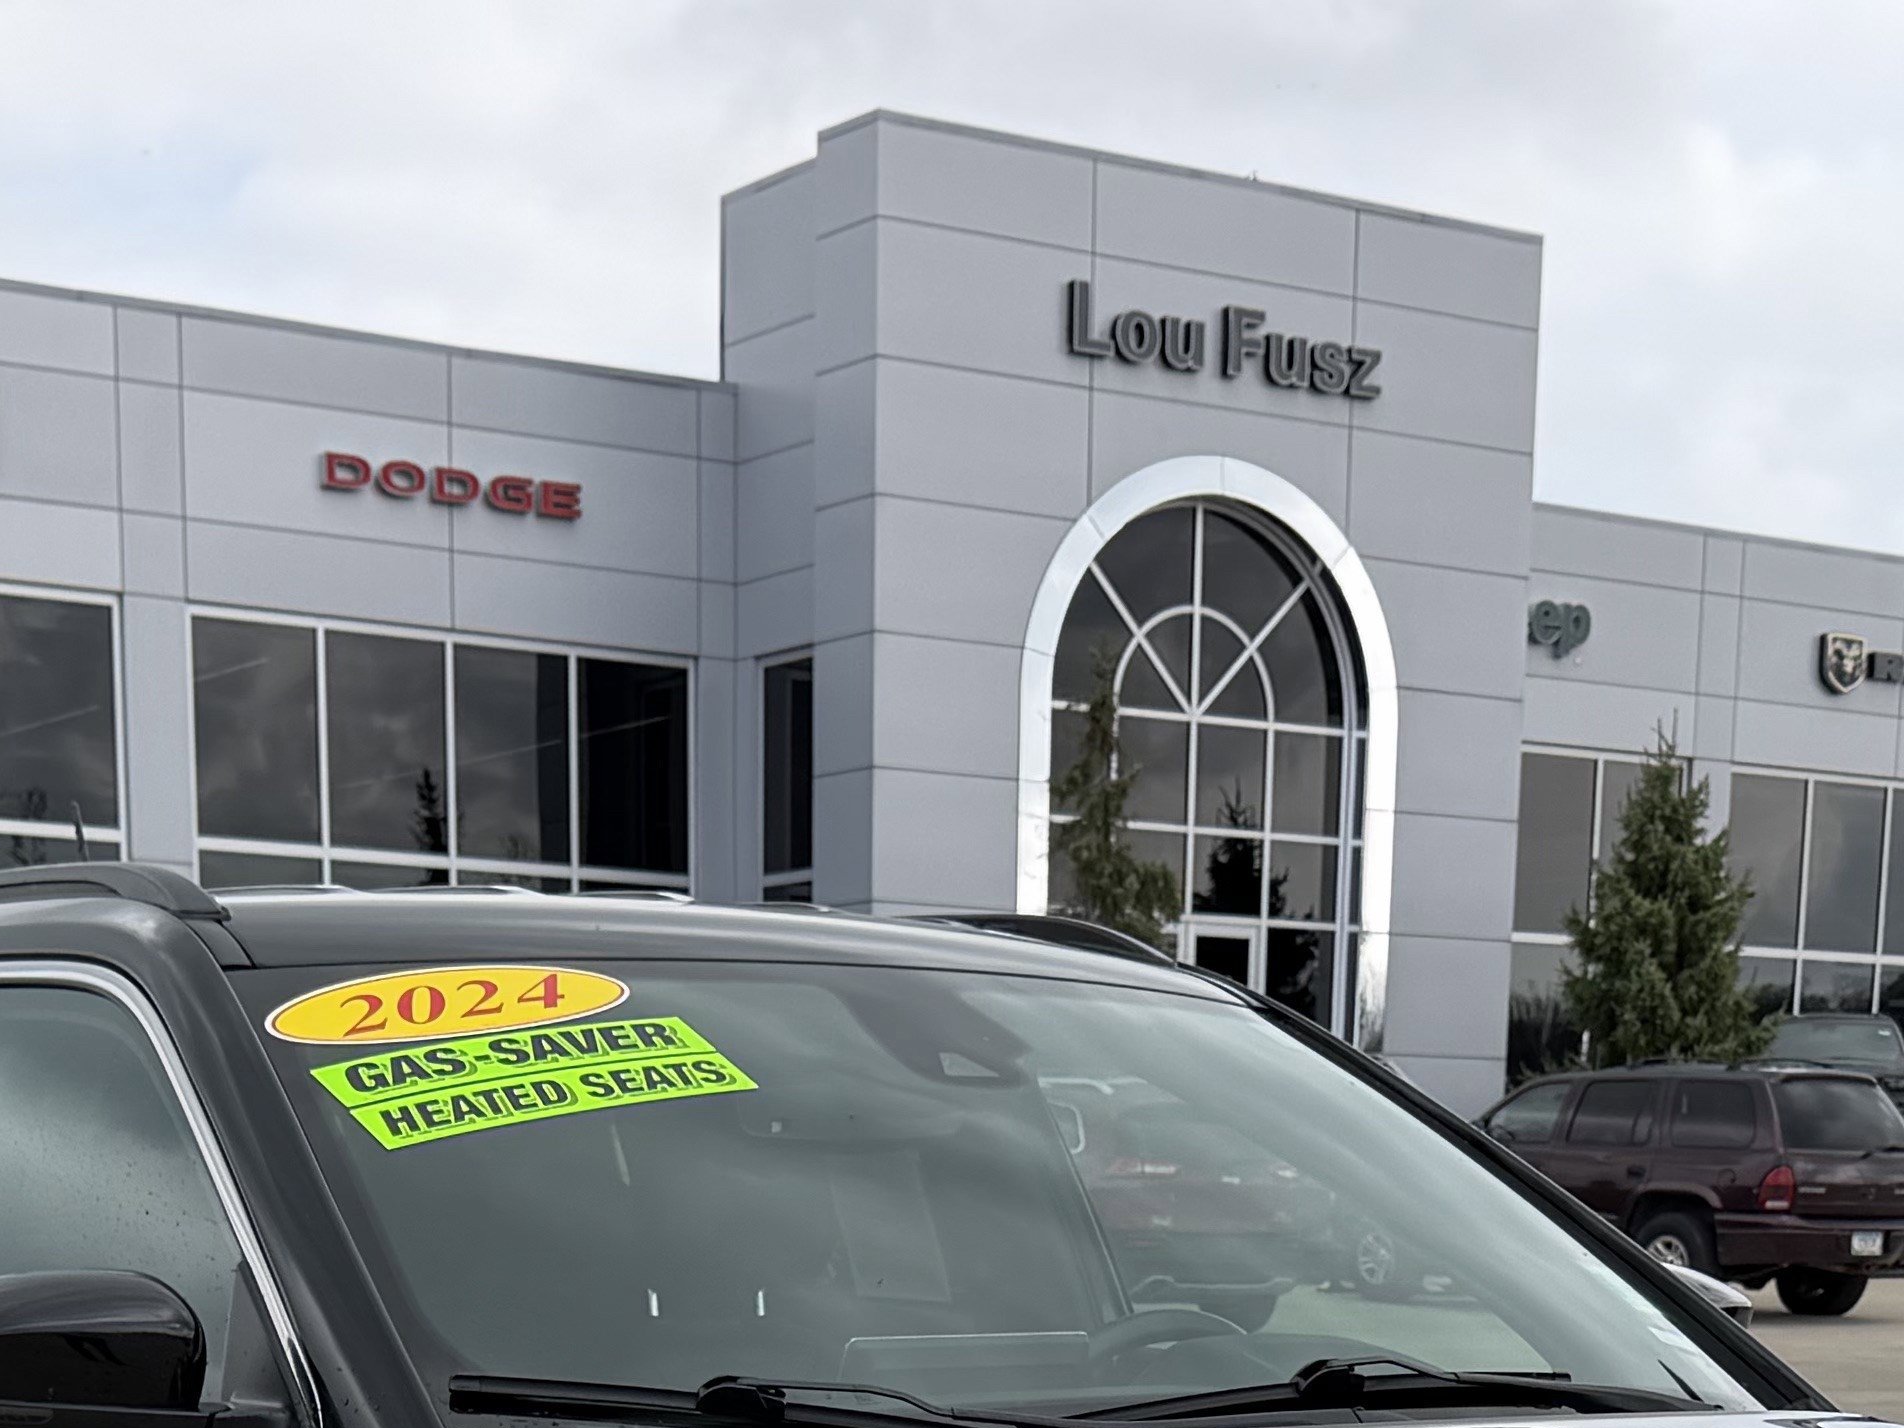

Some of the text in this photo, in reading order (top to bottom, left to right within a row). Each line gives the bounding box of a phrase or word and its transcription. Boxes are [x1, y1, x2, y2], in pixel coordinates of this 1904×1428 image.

[1067, 279, 1383, 401] Lou Fusz
[320, 451, 583, 521] DODGE
[340, 973, 566, 1037] 2024
[344, 1020, 688, 1093] GAS-SAVER
[378, 1058, 736, 1138] HEATED SEATS
